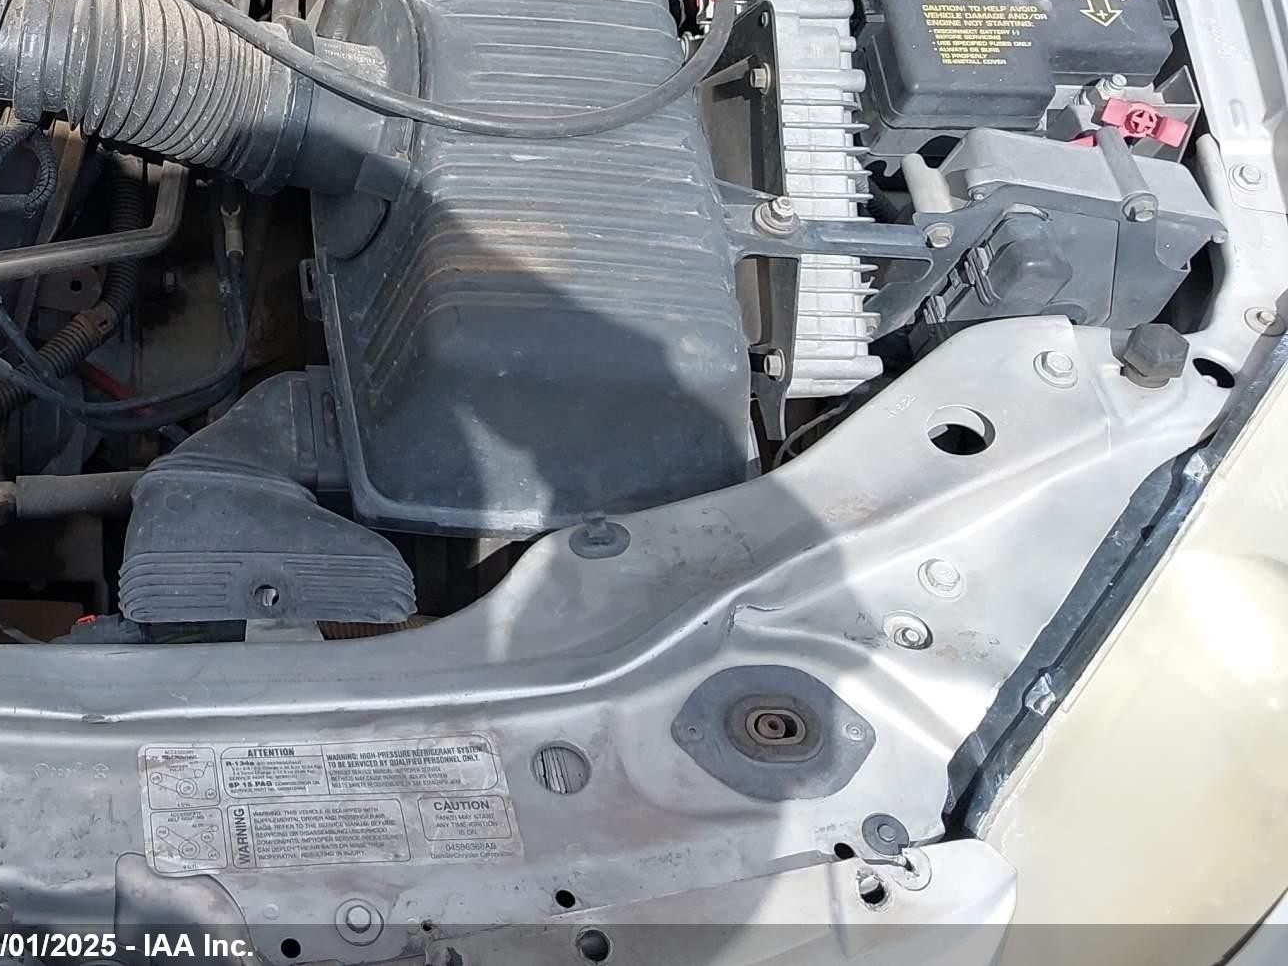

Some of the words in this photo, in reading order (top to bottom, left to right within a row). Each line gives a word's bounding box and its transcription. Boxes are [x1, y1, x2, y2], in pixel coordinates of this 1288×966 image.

[922, 4, 966, 12] CAUTION!
[1009, 5, 1038, 13] AVOID
[926, 19, 962, 27] ENGINE
[248, 747, 295, 757] ATTENTION
[326, 753, 358, 761] WARNING:
[360, 750, 410, 760] HIGH-PRESSURE
[412, 747, 455, 757] REFRIGERANT
[327, 760, 337, 768] TO
[347, 759, 378, 768] SERVICED
[389, 758, 423, 766] QUALIFIED
[423, 756, 461, 764] PERSONNEL
[434, 800, 489, 811] CAUTION
[233, 808, 250, 865] WARNING
